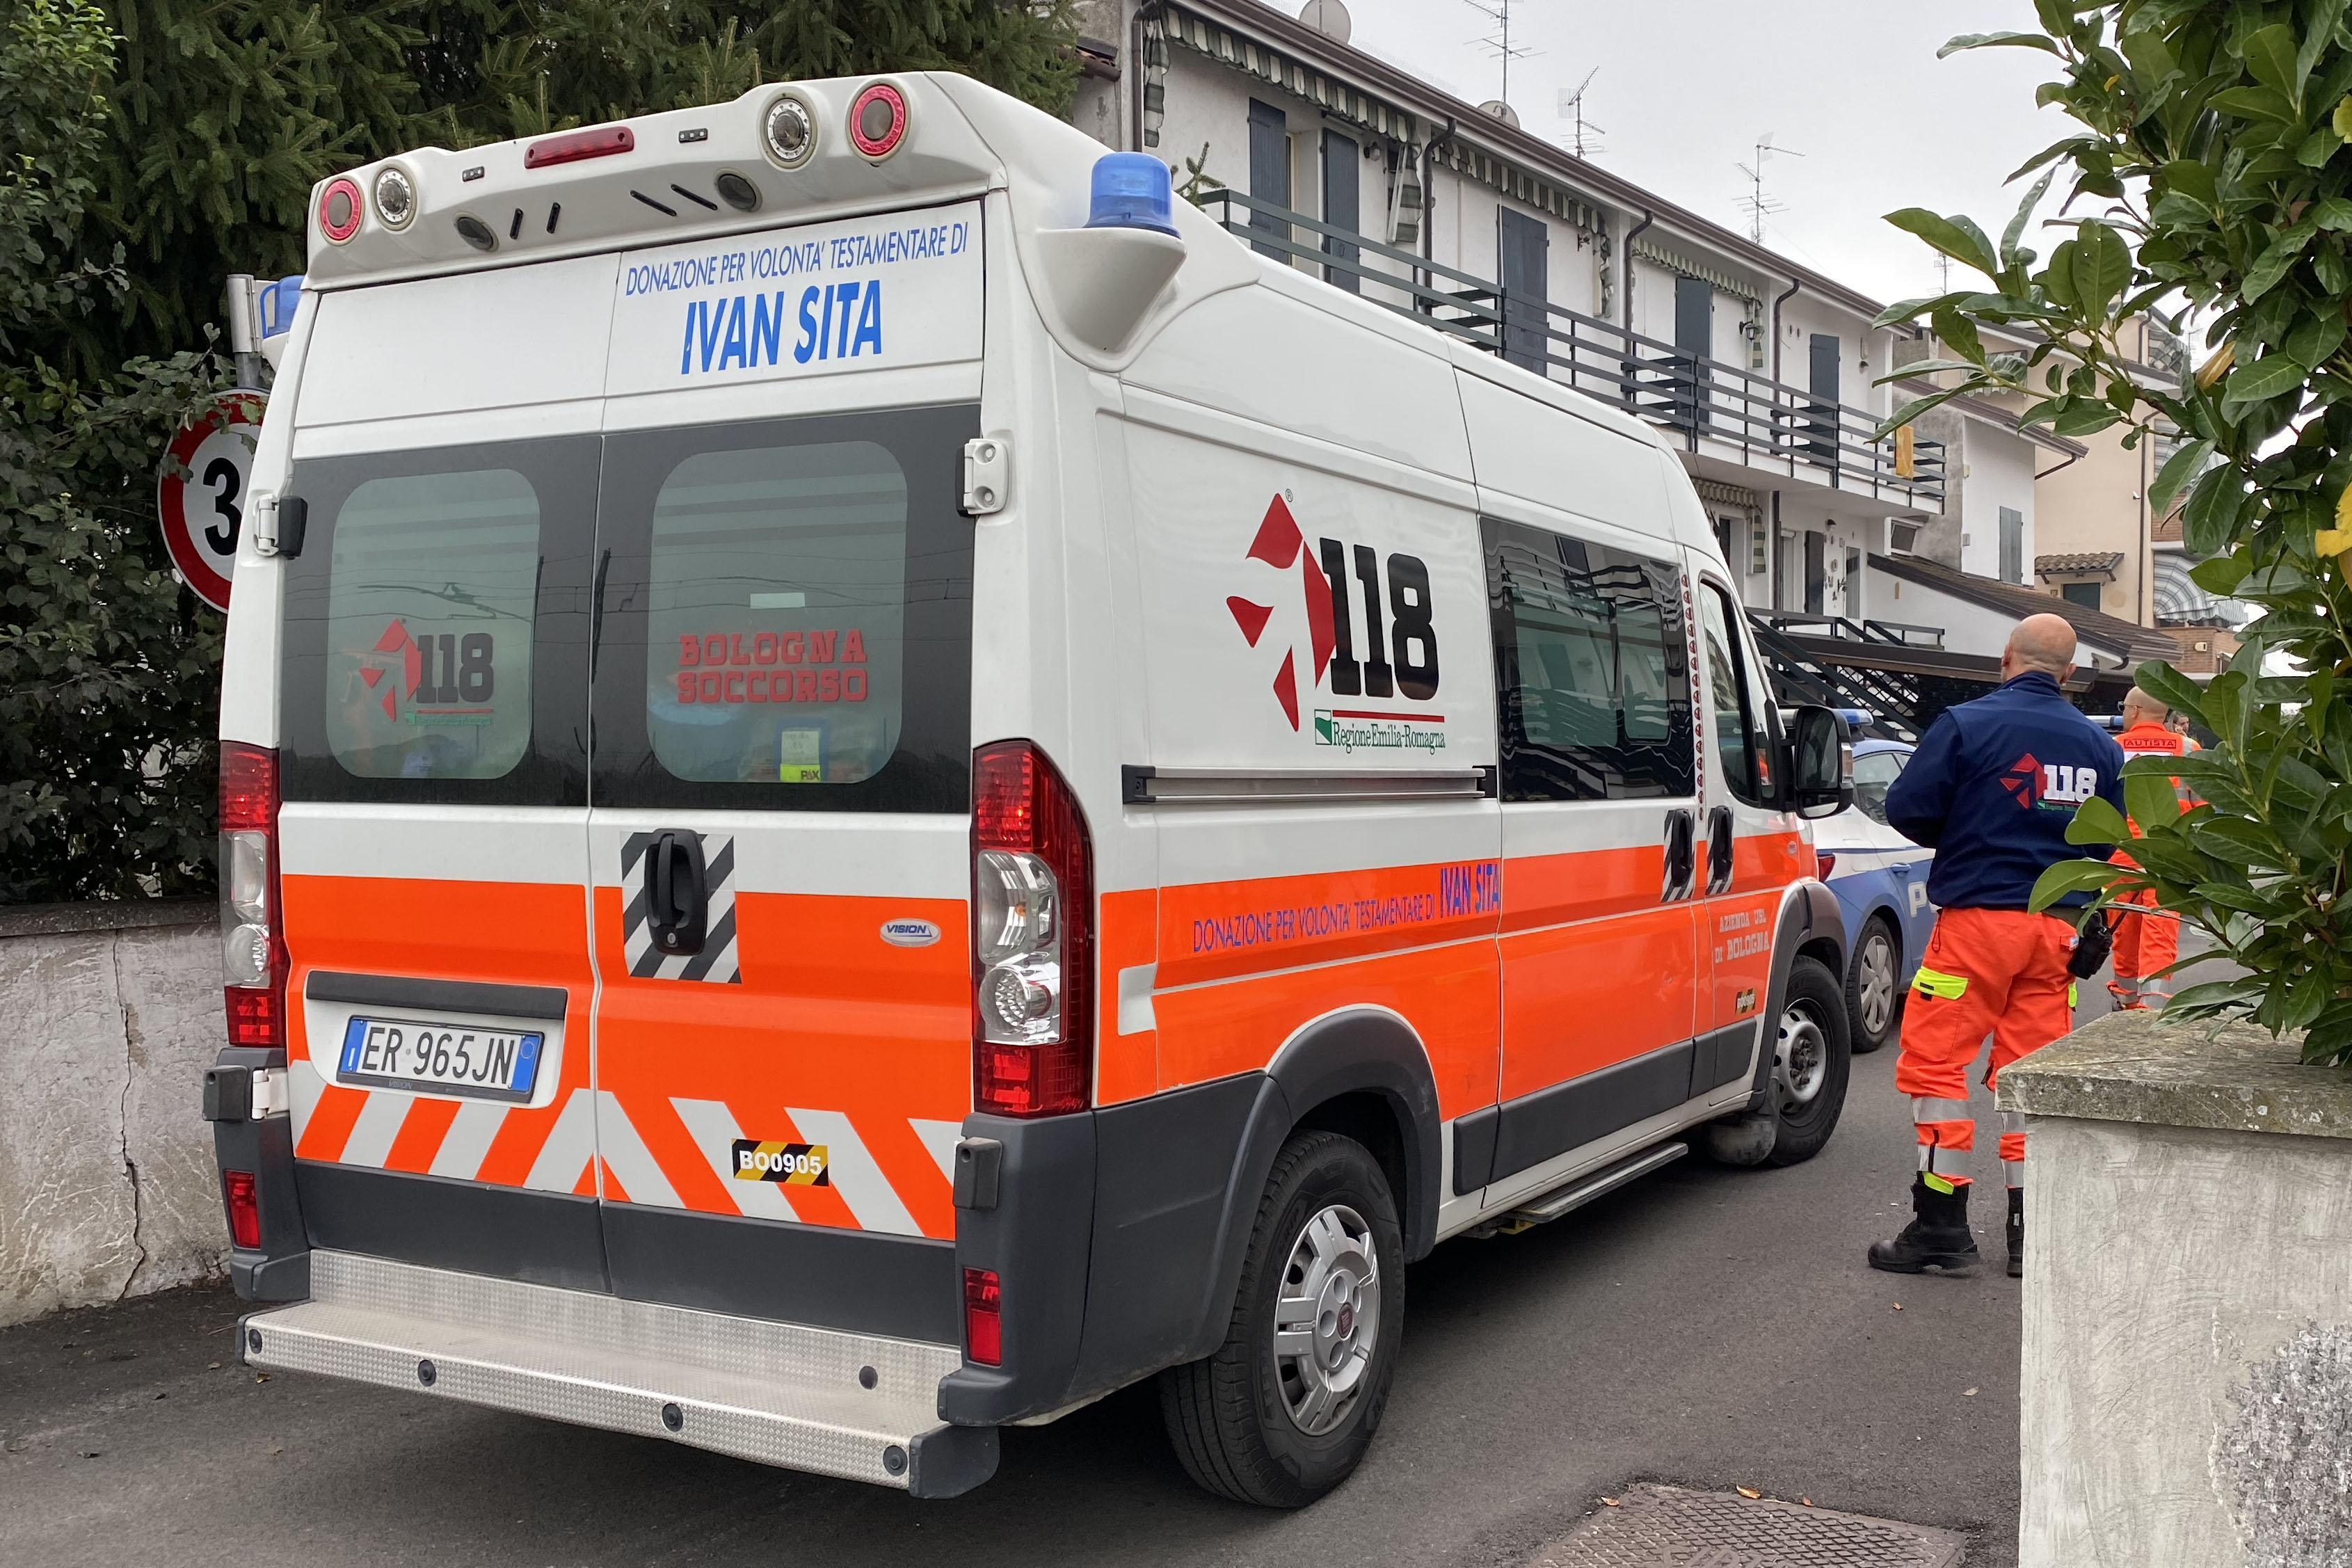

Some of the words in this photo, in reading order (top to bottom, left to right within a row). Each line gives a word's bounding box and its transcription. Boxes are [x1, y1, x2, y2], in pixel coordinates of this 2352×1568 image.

[626, 256, 716, 296] DONAZIONE
[720, 253, 744, 283] PER
[831, 225, 948, 269] TESTAMENTARE
[952, 221, 968, 253] DI
[681, 291, 785, 374] IVAN
[794, 280, 881, 364] SITA
[203, 458, 241, 556] 3
[1320, 537, 1439, 701] 118
[679, 628, 867, 666] BOLOGNA
[416, 633, 494, 703] 118
[678, 669, 868, 703] SOCCORSO
[2043, 765, 2097, 802] 118
[1193, 912, 1272, 953] DONAZIONE
[1276, 909, 1295, 940] PER
[1354, 893, 1423, 929] TESTAMENTARE
[1425, 894, 1434, 920] DI
[1440, 865, 1471, 918] IVAN
[1475, 863, 1500, 914] SITA
[1720, 912, 1750, 933] AZIENDA
[1754, 908, 1766, 925] USL
[887, 925, 927, 934] VISION
[1715, 946, 1723, 963] DI
[1727, 931, 1770, 960] BOLOGNA
[362, 1027, 403, 1072] ER
[387, 1079, 413, 1090] VISION
[739, 1150, 822, 1175] BO0905
